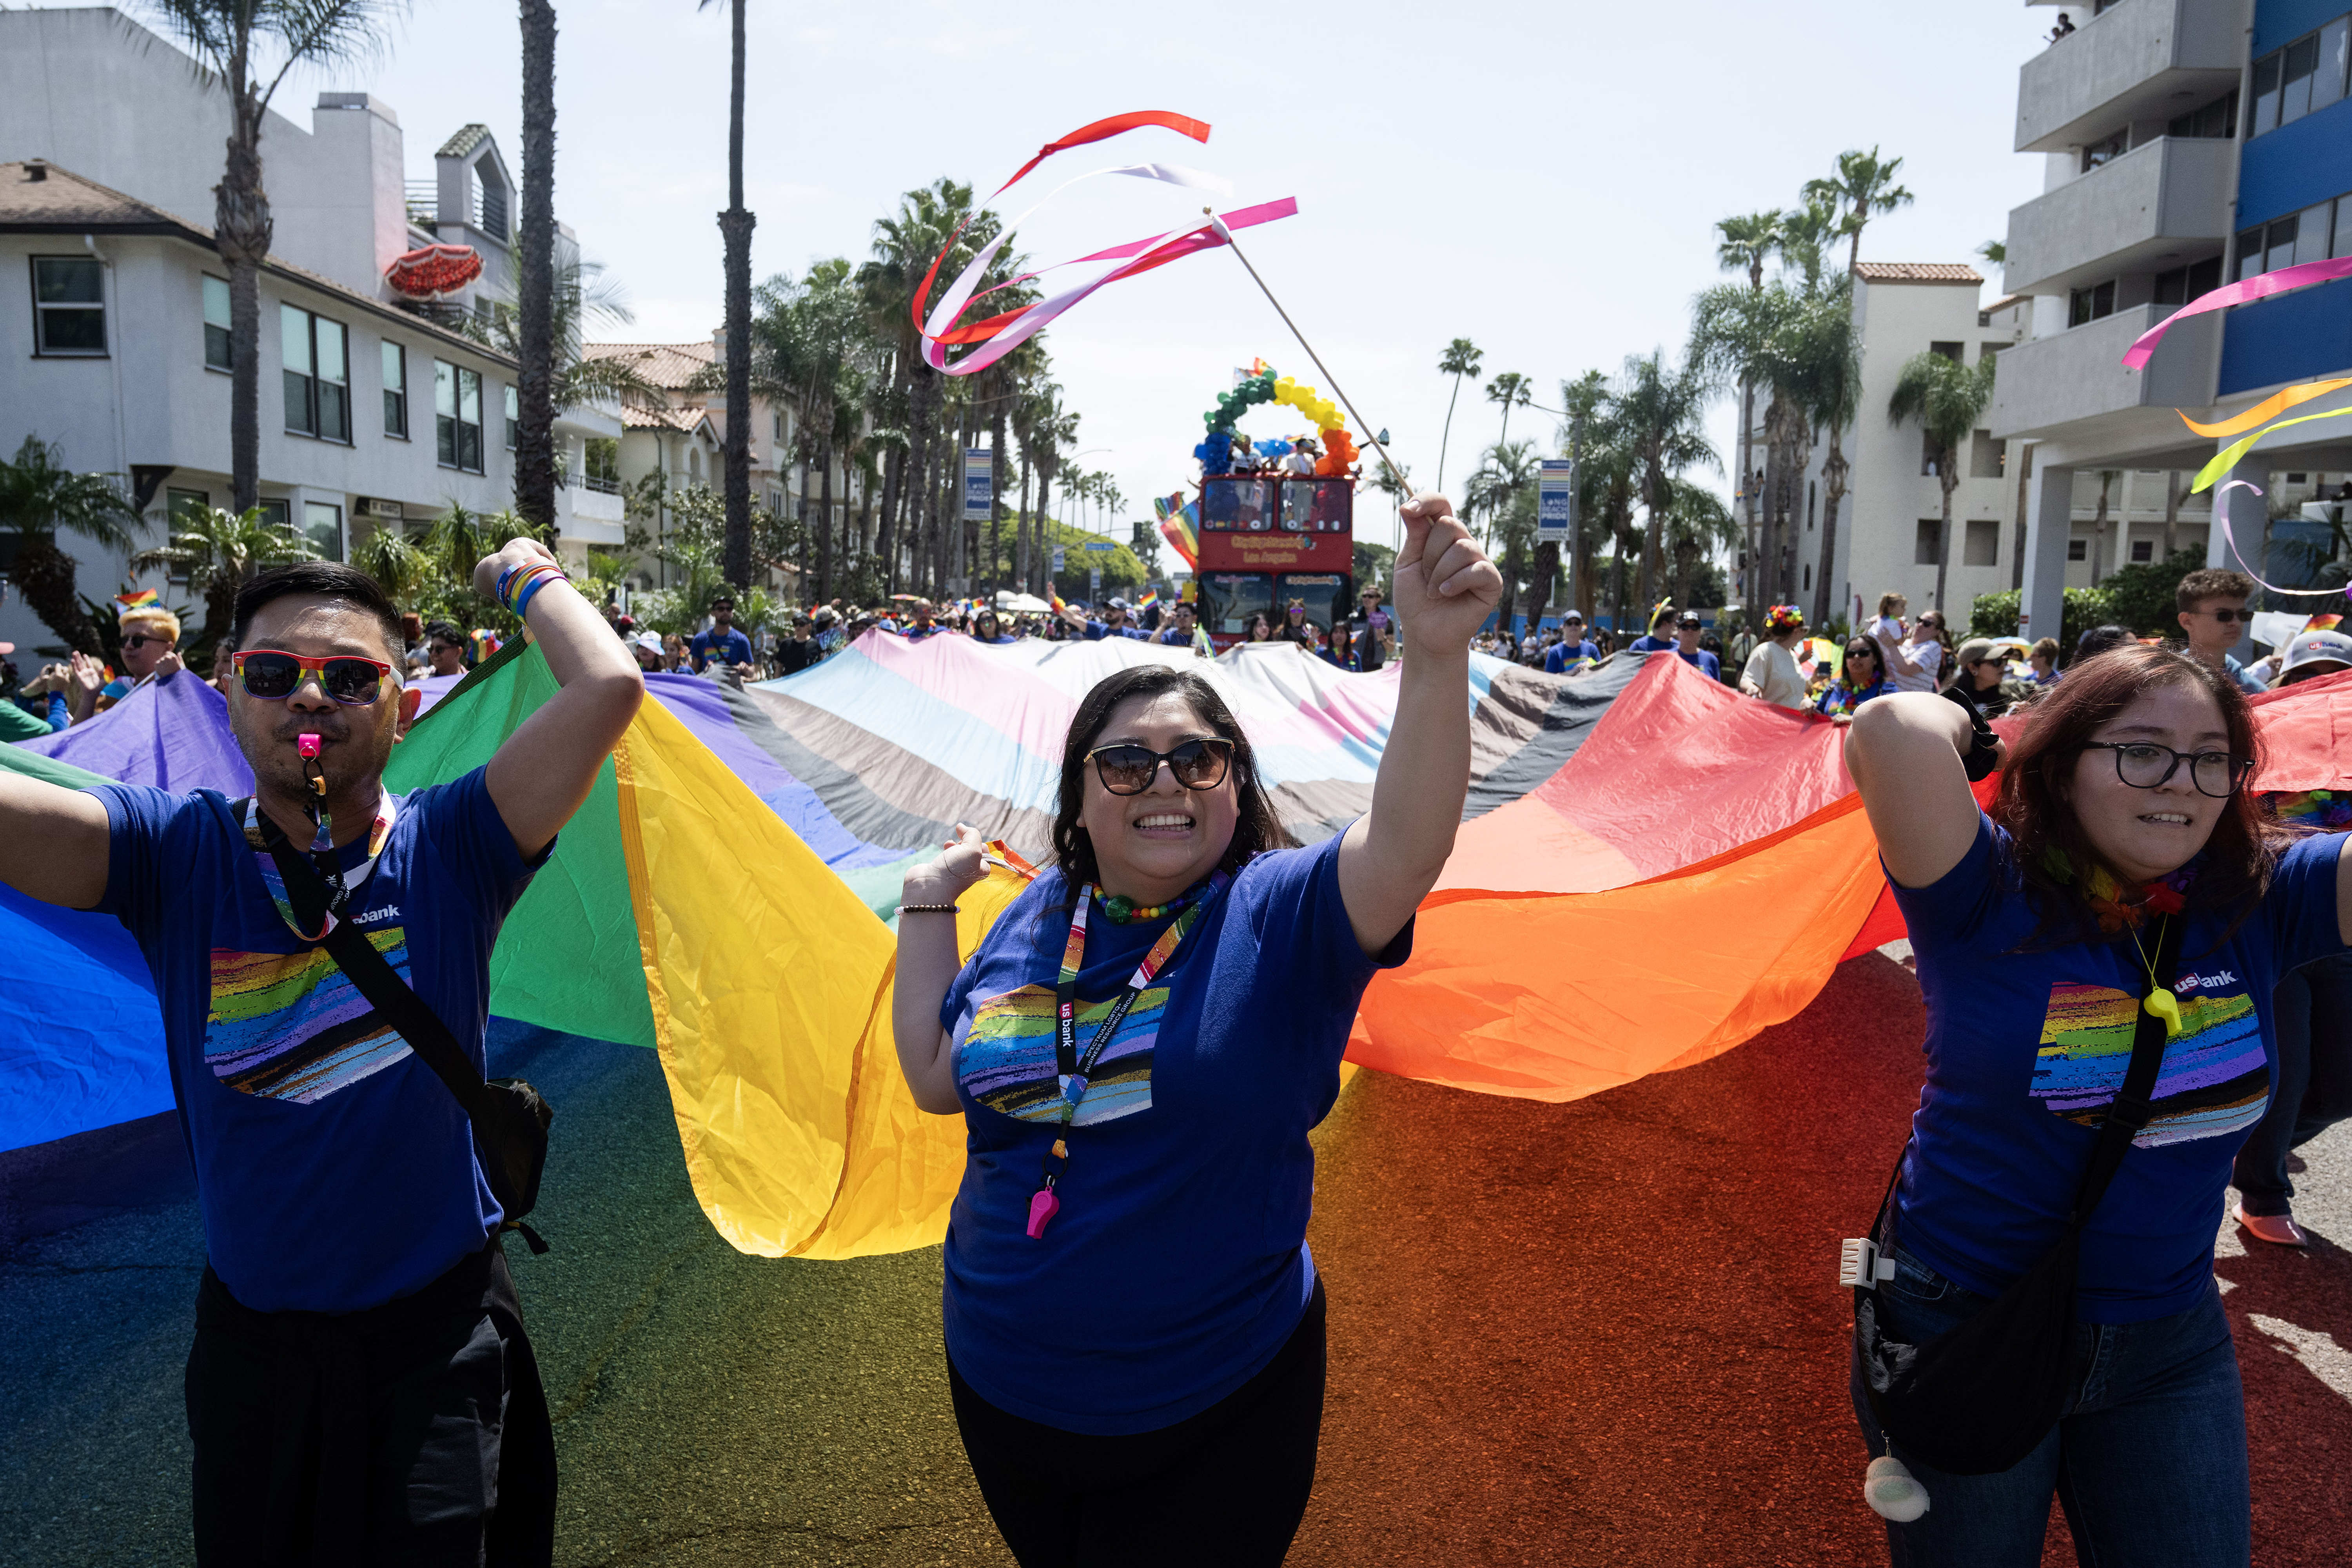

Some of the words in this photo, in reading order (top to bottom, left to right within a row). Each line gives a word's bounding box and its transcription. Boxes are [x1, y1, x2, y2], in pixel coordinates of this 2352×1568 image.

[2174, 970, 2237, 993] usank
[1085, 1043, 1102, 1073] BUSINESS
[1101, 1012, 1123, 1043] RESOURCE
[1121, 992, 1135, 1012] GROUP
[1086, 1025, 1107, 1057] SPECTRUM
[1105, 1003, 1121, 1025] LGBTQ+
